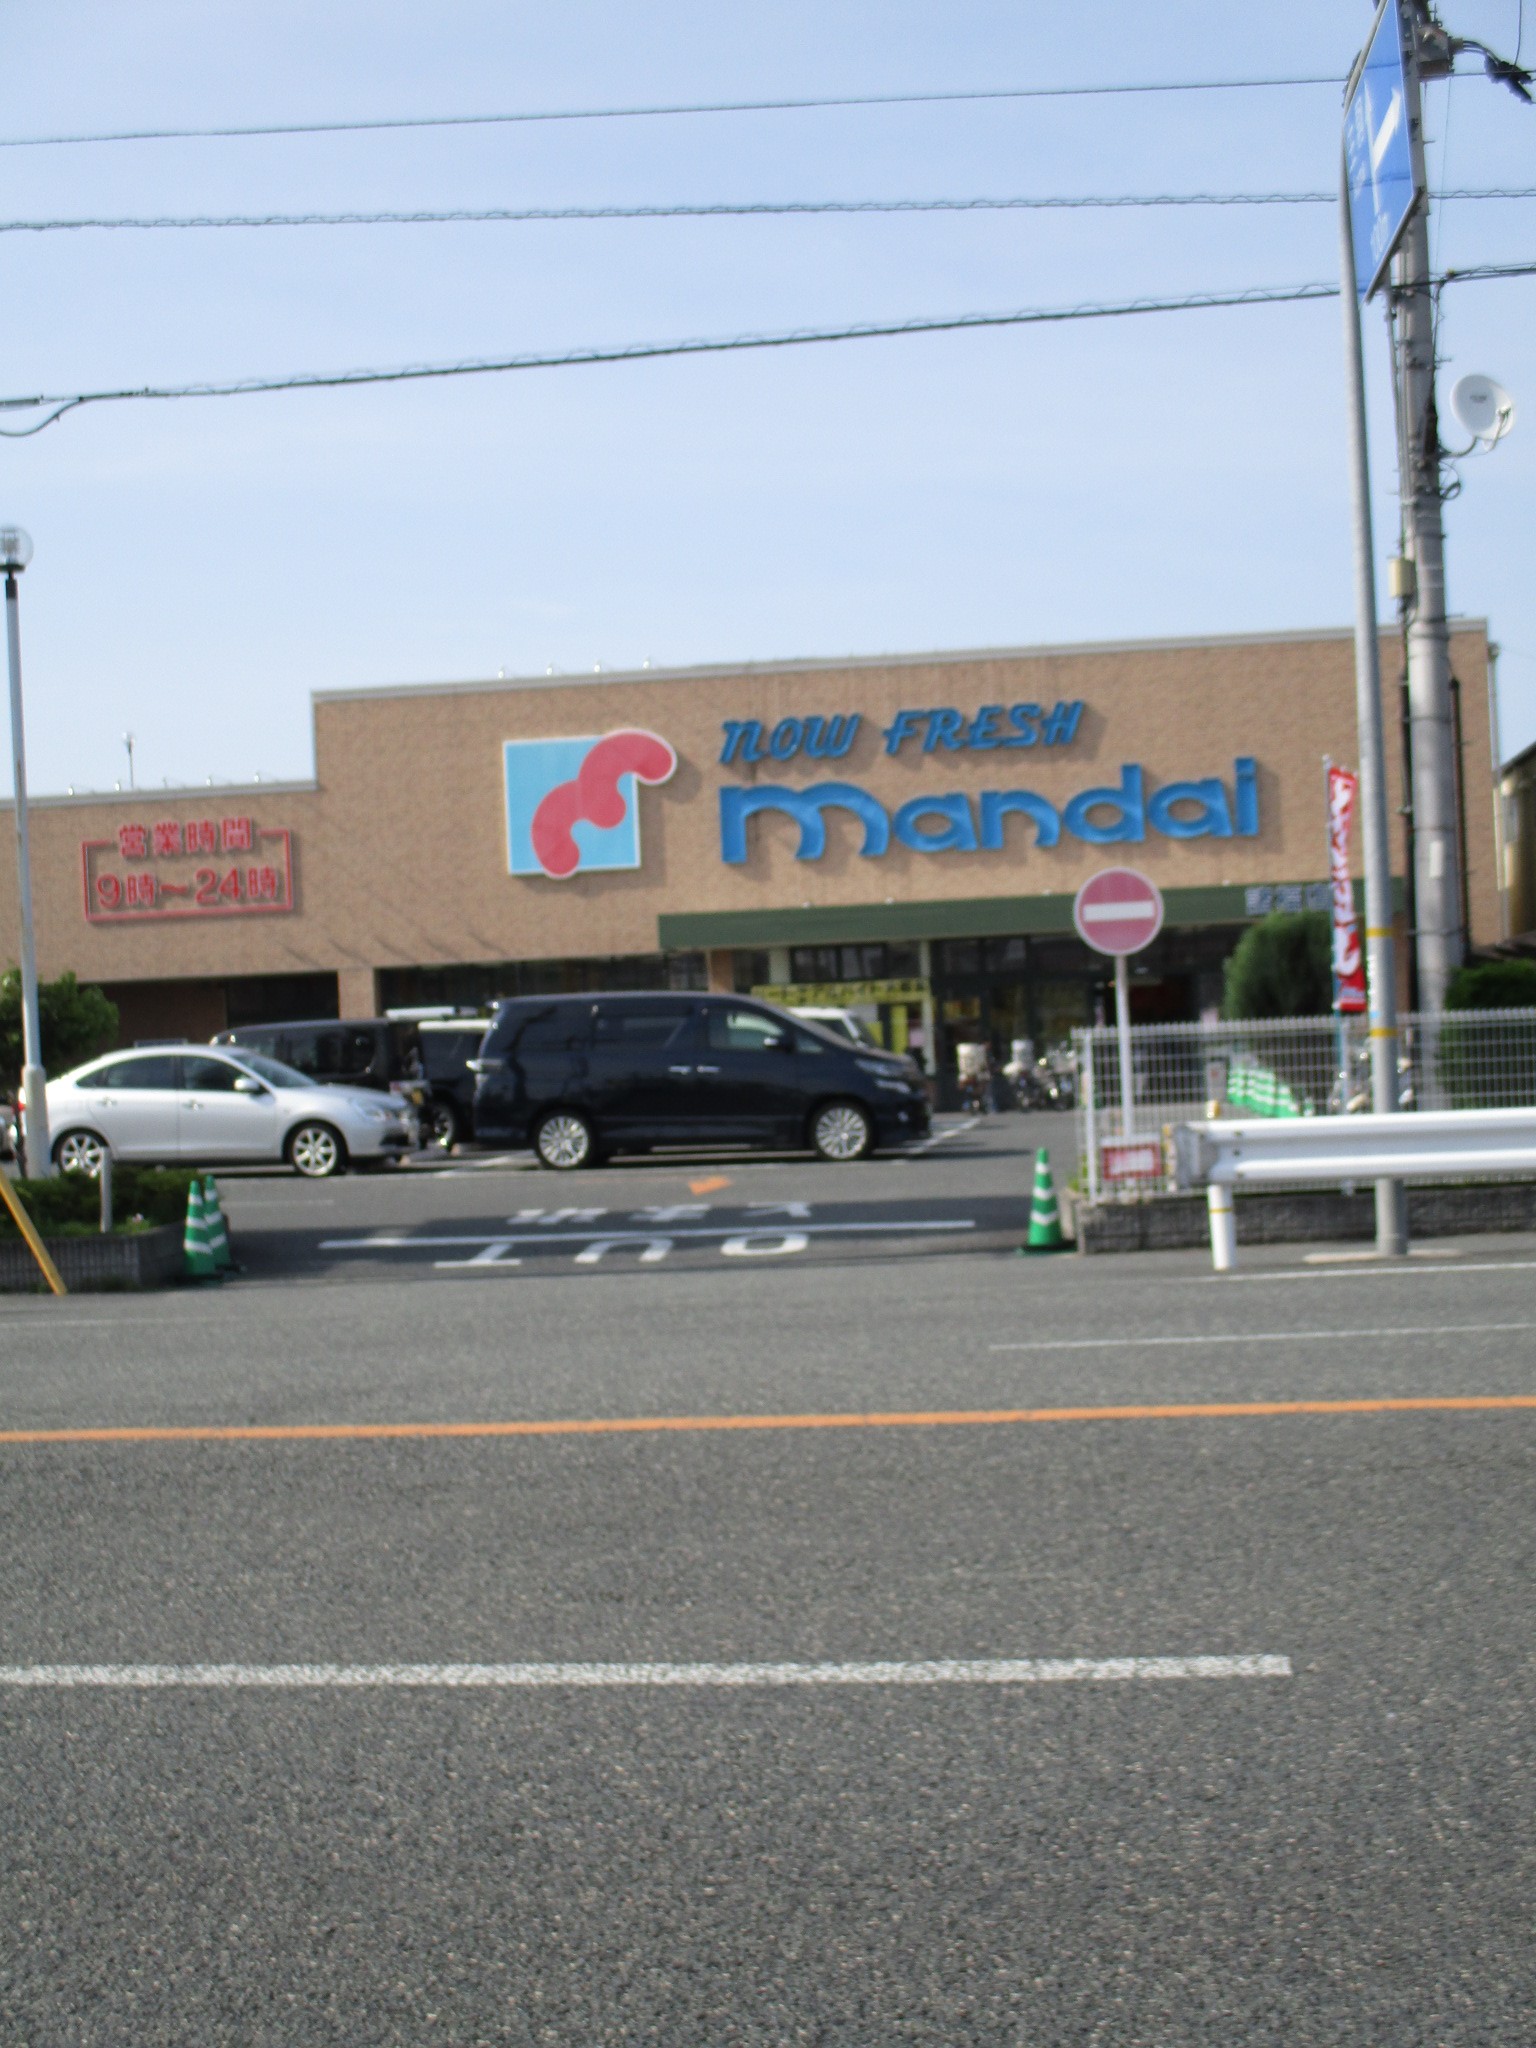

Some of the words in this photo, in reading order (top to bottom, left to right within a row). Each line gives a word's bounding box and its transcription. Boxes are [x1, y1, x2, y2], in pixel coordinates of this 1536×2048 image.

[883, 701, 1085, 756] FRESH
[119, 816, 253, 858] 営業時間
[719, 757, 1259, 865] mandai
